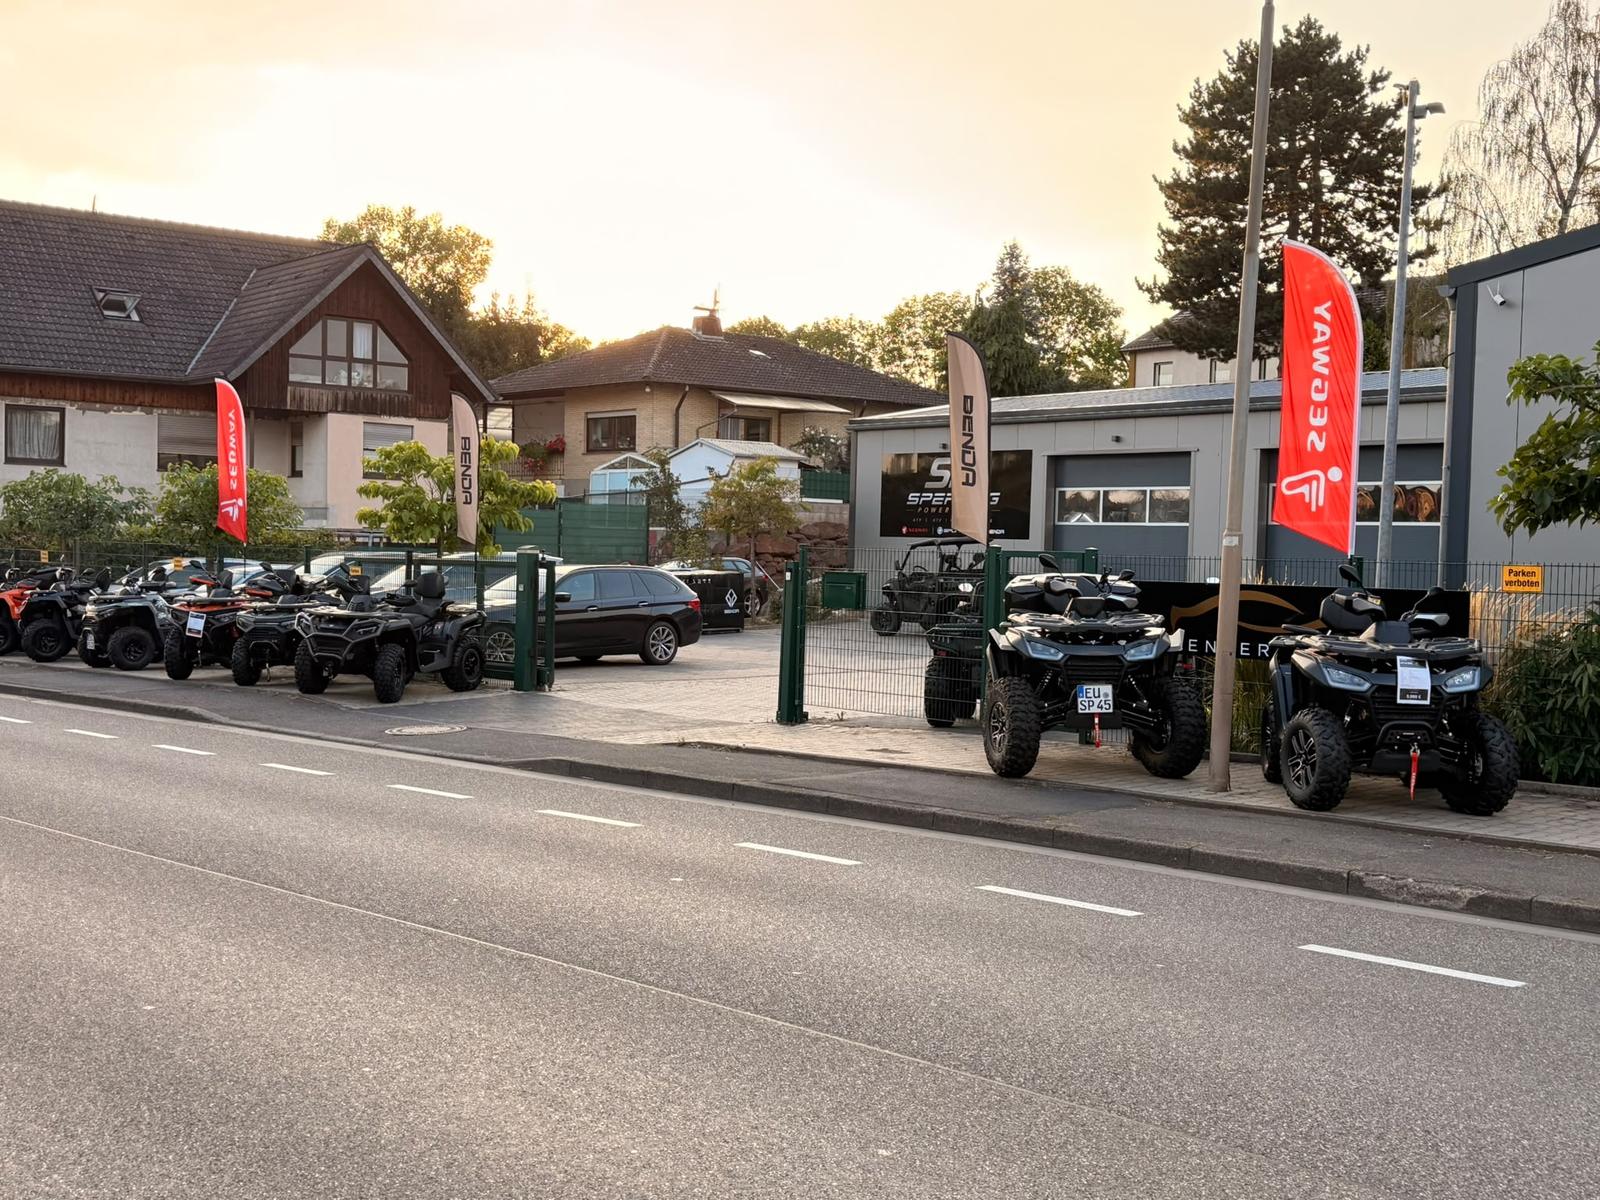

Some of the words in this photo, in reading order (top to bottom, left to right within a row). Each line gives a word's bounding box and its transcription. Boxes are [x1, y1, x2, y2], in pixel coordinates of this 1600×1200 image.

[961, 395, 977, 488] BENDA
[460, 436, 473, 506] BENDA
[1508, 568, 1537, 578] Parken
[1504, 578, 1540, 588] verboten
[1084, 687, 1102, 699] EU
[1079, 699, 1095, 711] SP
[1096, 699, 1112, 711] 45
